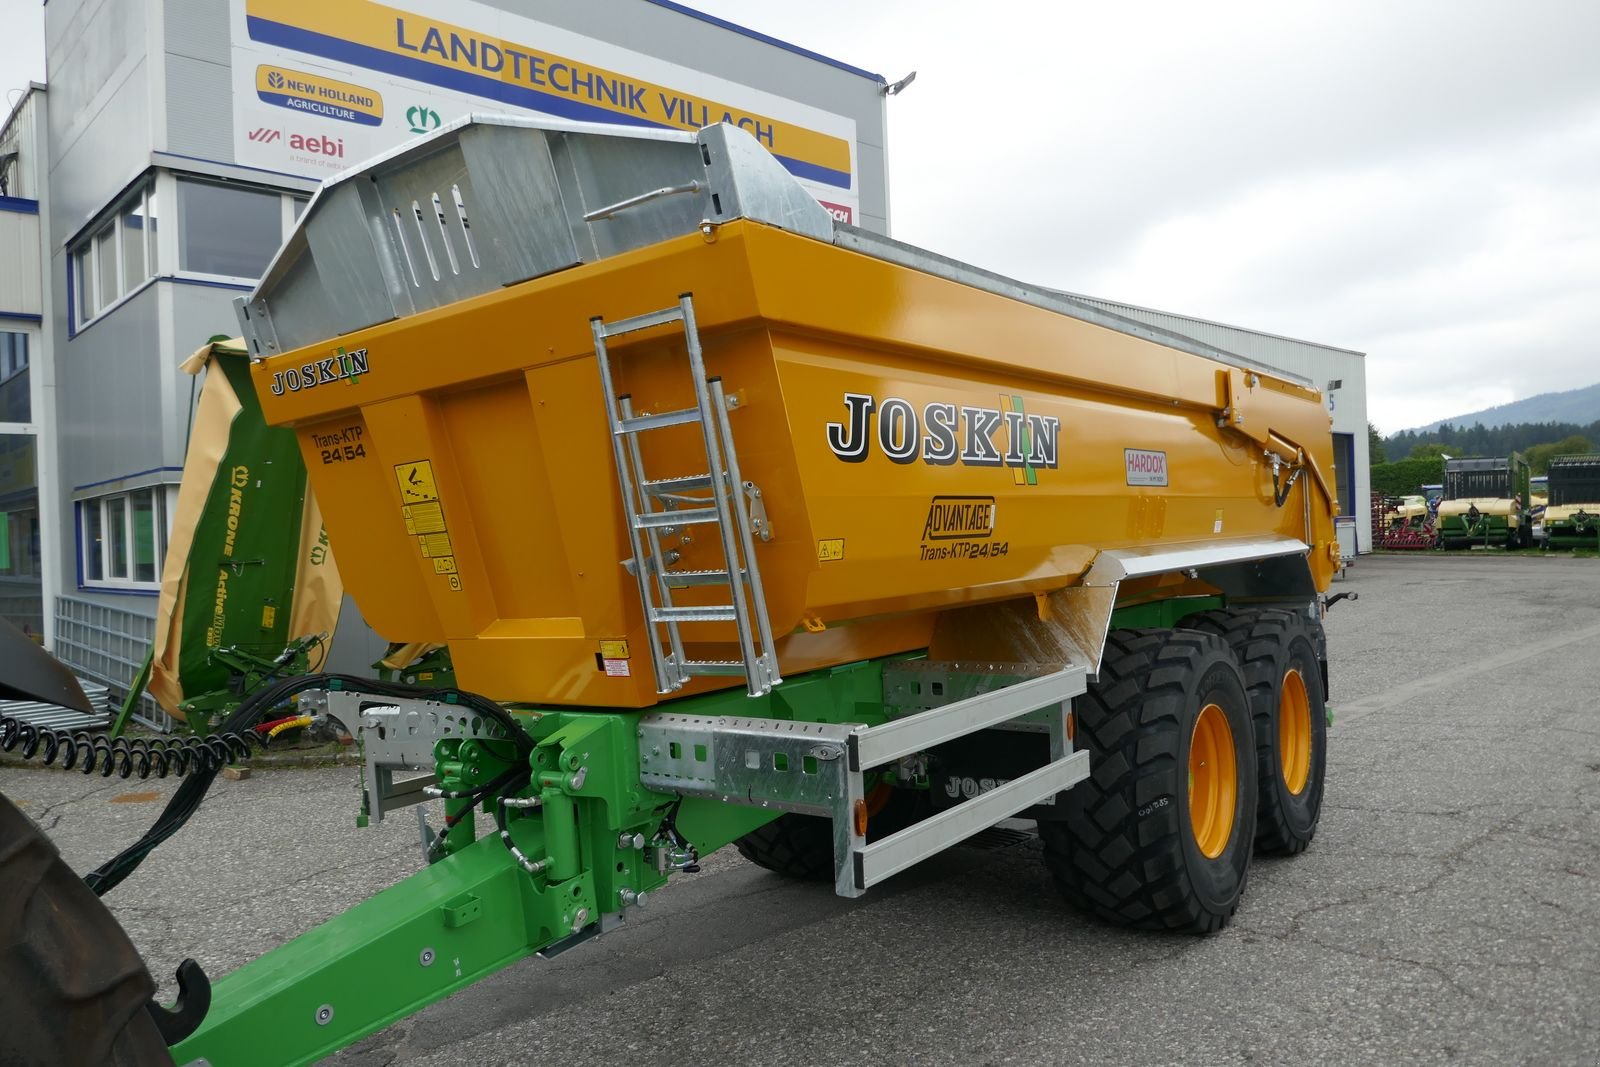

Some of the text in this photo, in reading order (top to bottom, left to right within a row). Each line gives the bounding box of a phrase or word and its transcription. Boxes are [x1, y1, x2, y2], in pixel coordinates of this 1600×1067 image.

[396, 17, 647, 114] LANDTECHNIK
[287, 79, 373, 108] NEW HOLLAND
[286, 98, 355, 120] AGRICULTURE
[289, 133, 344, 158] aebi
[270, 349, 370, 396] JOSKIN
[312, 425, 363, 449] Trans-KTP
[826, 392, 1061, 469] JOSKIN
[321, 443, 366, 465] 24/54
[1127, 453, 1164, 474] HARDOX
[223, 487, 242, 557] KRONE
[922, 504, 991, 541] ADVANTAGE
